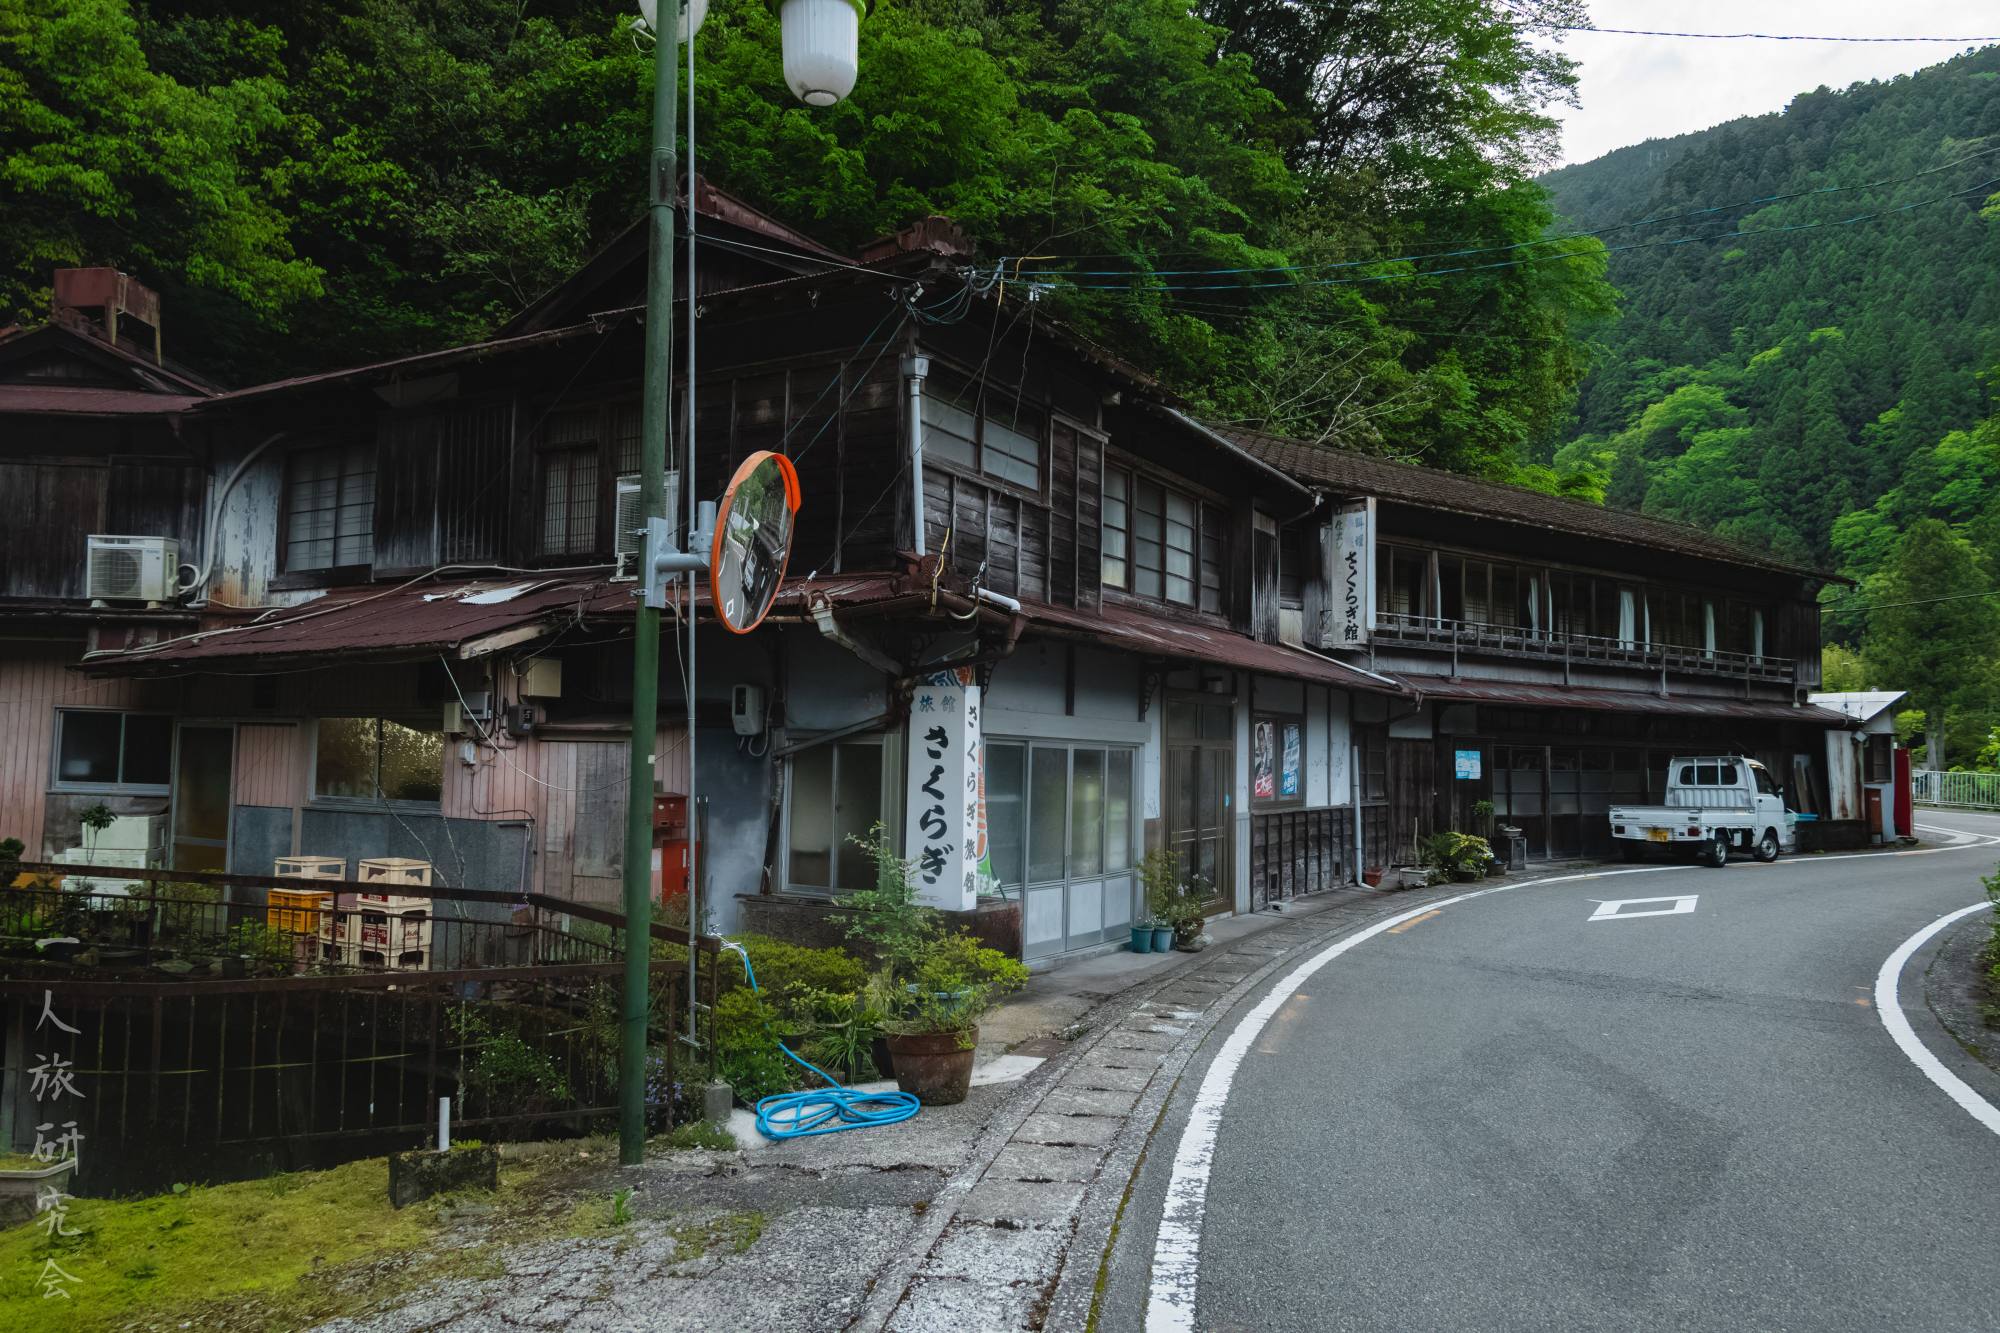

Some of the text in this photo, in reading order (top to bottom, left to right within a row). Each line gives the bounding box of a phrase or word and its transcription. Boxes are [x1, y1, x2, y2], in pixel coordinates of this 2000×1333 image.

[1344, 551, 1359, 641] さくらぎ館
[919, 695, 956, 713] 旅館
[919, 725, 954, 885] さくらぎ
[963, 705, 978, 893] さくらぎ旅館
